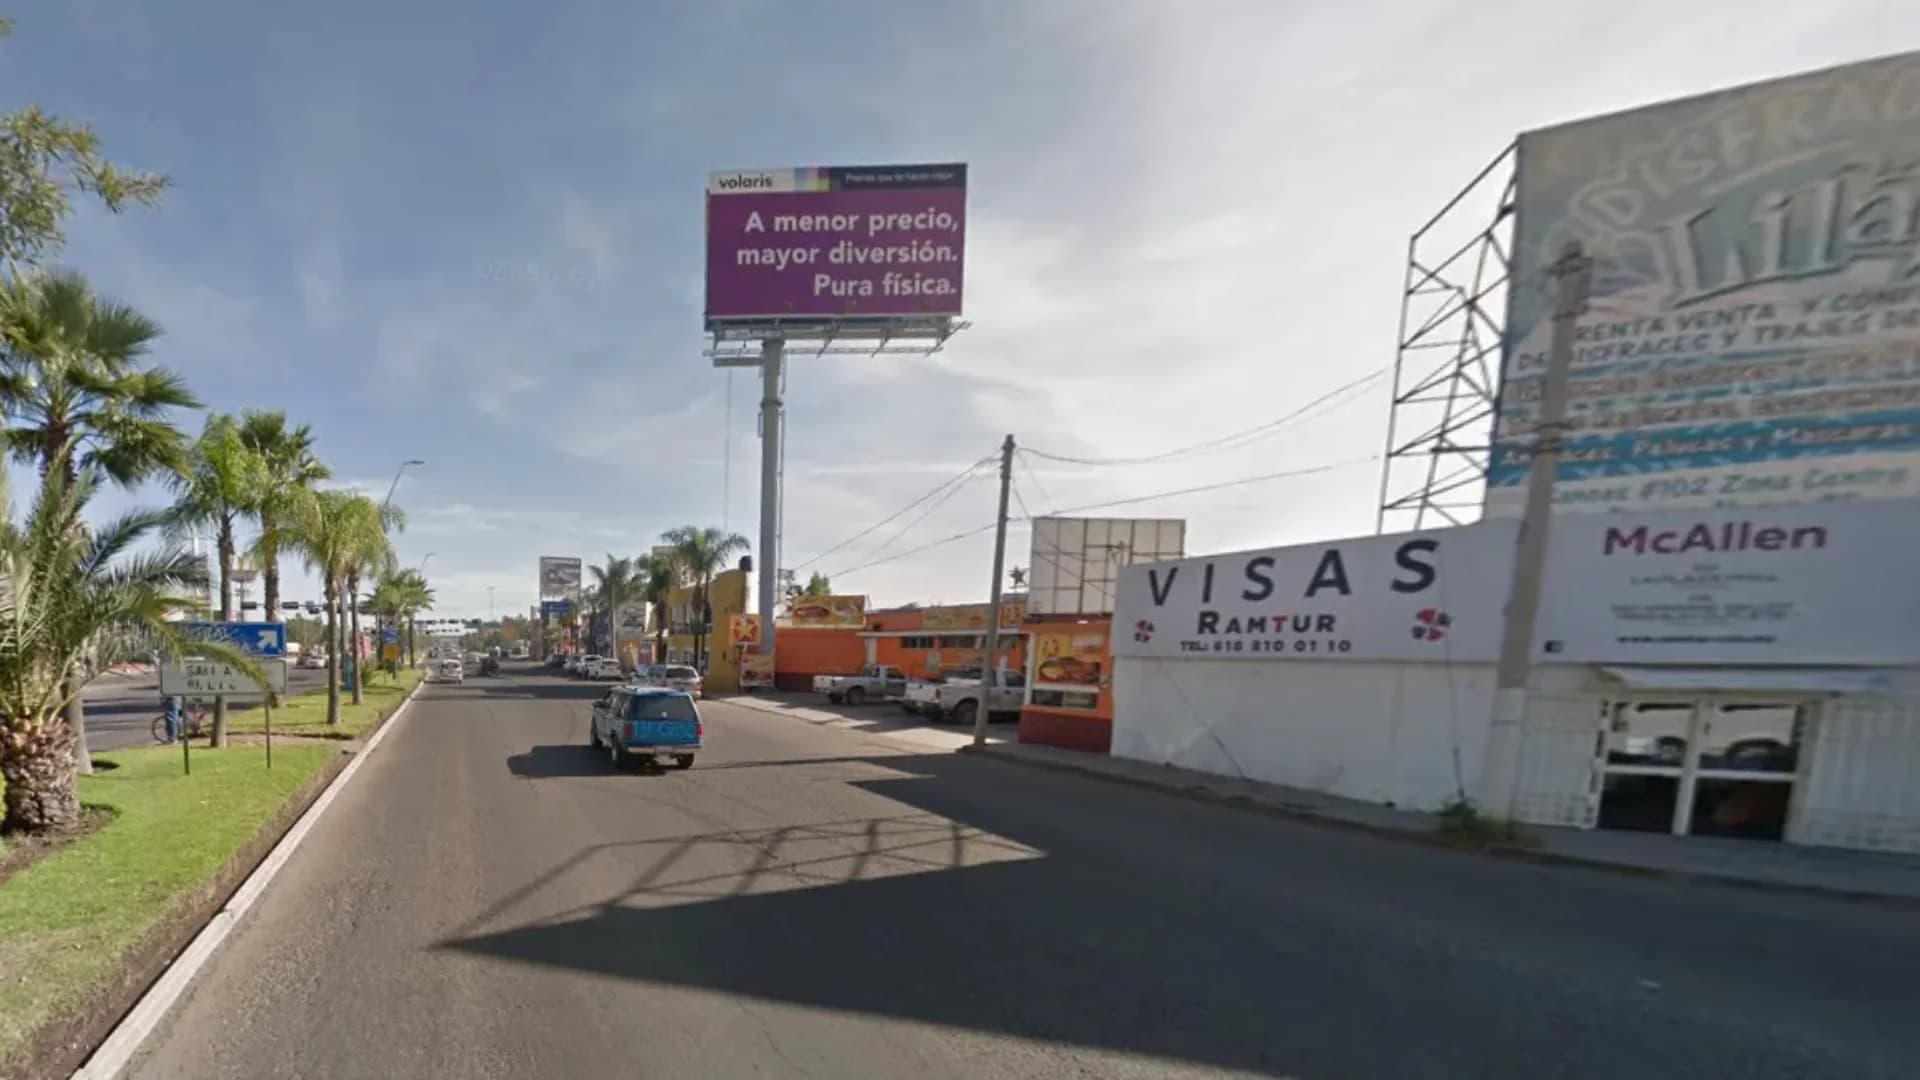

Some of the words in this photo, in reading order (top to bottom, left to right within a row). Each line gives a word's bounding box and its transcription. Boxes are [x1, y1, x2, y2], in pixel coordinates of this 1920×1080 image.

[719, 174, 773, 189] volaris
[744, 211, 765, 232] A
[774, 214, 859, 232] menor
[869, 207, 959, 236] precio,
[737, 246, 820, 270] mayor
[829, 239, 958, 264] diversión.
[814, 274, 873, 296] Pura
[882, 272, 957, 295] física.
[1677, 302, 1776, 331] VENTA
[1567, 333, 1710, 363] ISFRACES
[1721, 329, 1740, 347] Y
[1753, 311, 1872, 343] TRAJES
[1603, 522, 1828, 556] McAllen
[1148, 539, 1439, 607] VISAS
[1197, 611, 1336, 635] RAMTUR
[1294, 640, 1317, 651] 01
[1328, 640, 1352, 651] 10
